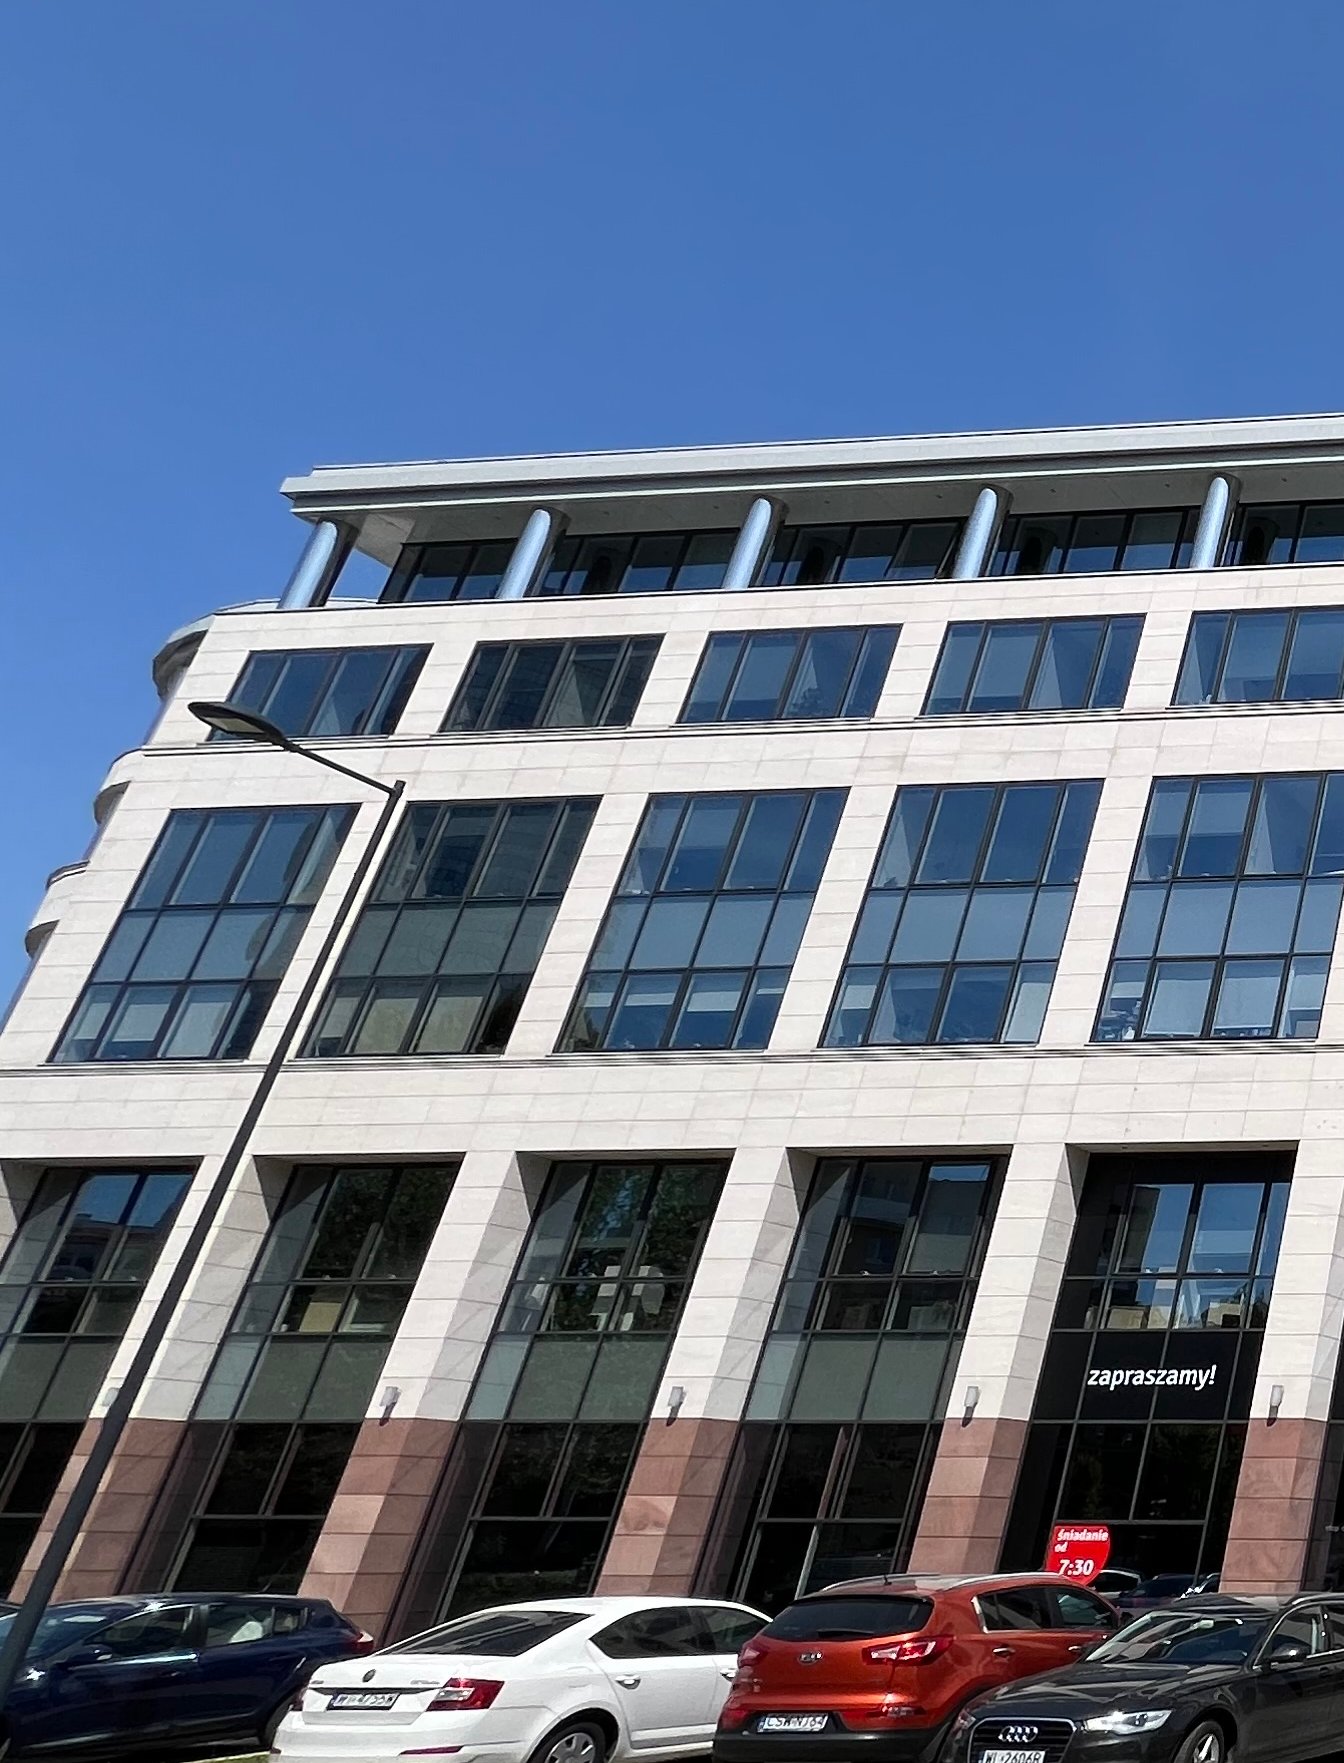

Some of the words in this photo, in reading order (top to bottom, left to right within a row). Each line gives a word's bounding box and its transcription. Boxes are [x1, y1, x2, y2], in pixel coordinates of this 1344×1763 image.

[1087, 1365, 1216, 1391] zapraszamy!
[1057, 1529, 1109, 1541] śniadanie
[1054, 1541, 1068, 1553] od
[1059, 1559, 1095, 1576] 7:30
